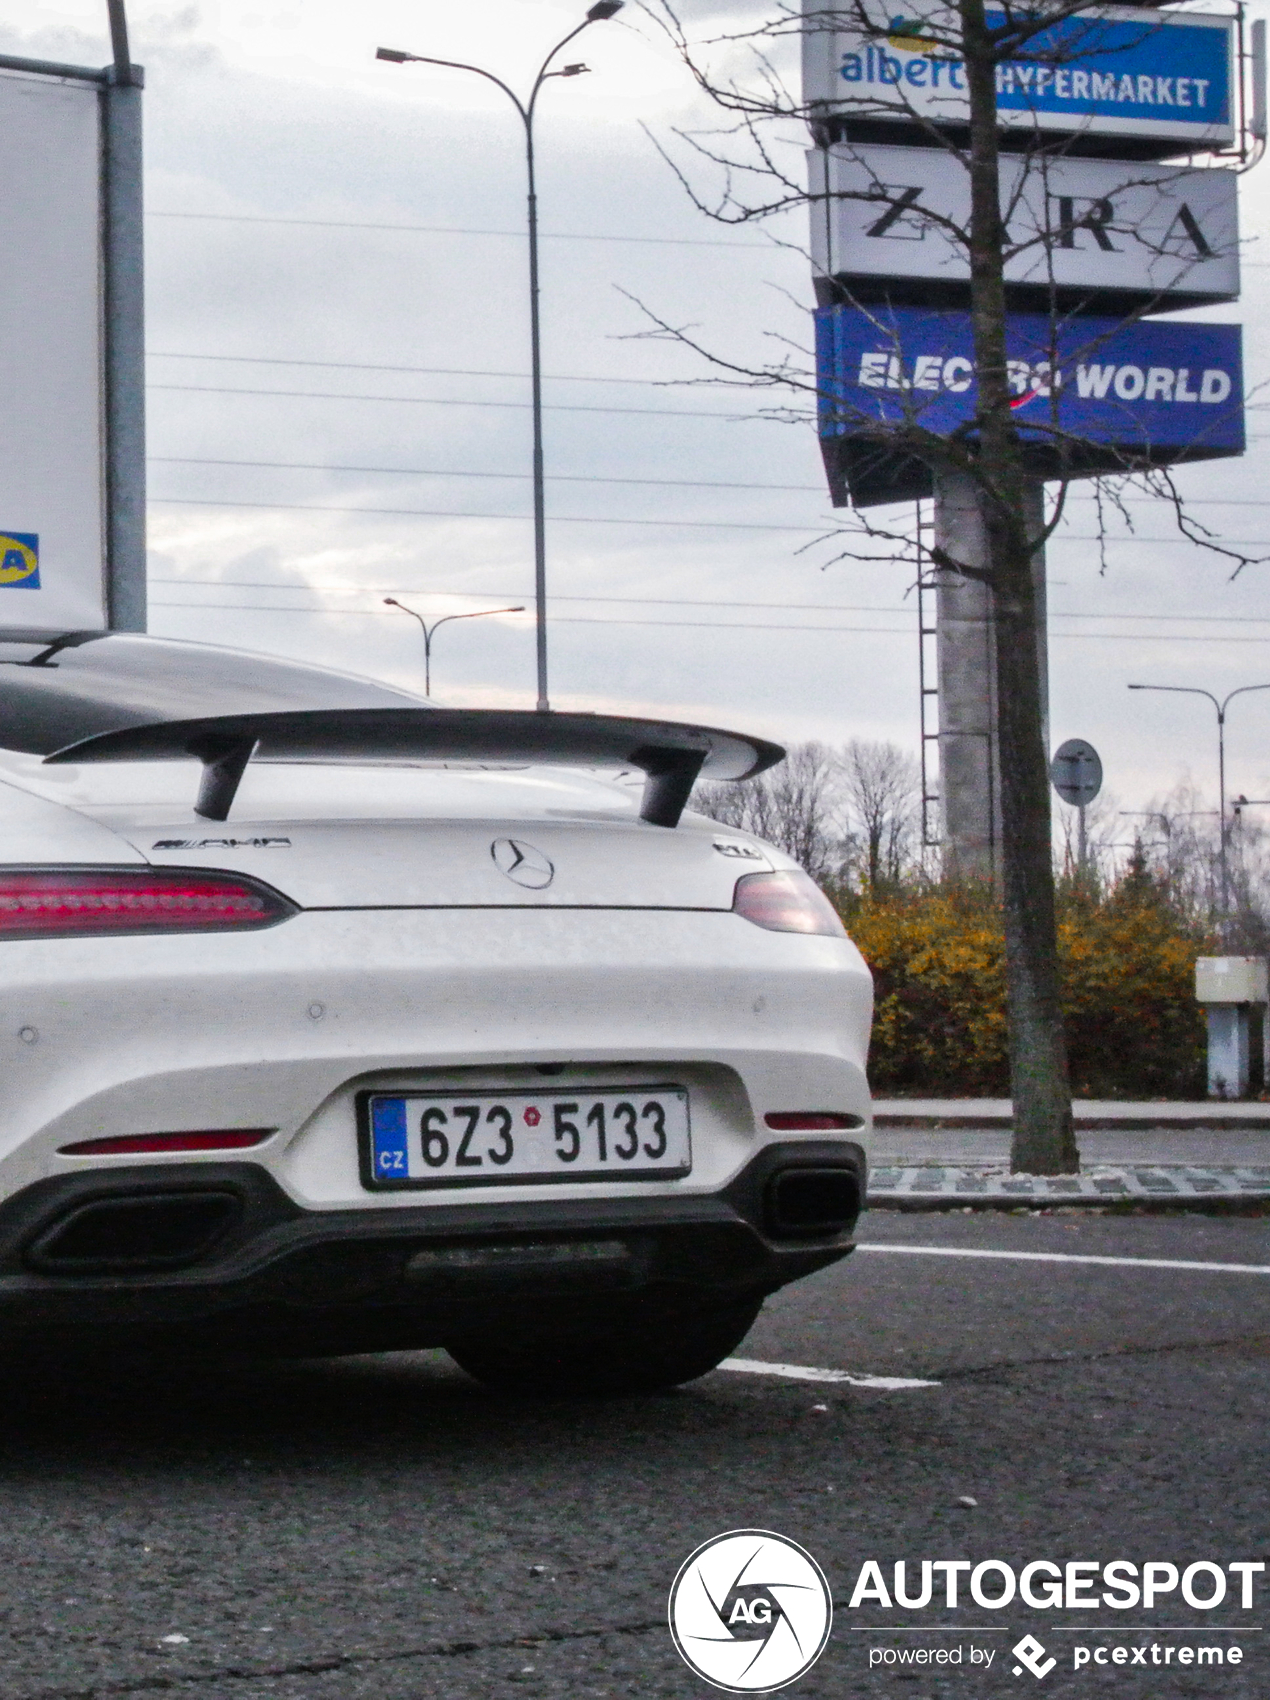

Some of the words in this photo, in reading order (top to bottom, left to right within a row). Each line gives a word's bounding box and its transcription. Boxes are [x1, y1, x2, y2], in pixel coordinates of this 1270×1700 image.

[841, 47, 965, 92] albert
[995, 63, 1210, 109] HYPERMARKET
[866, 183, 1223, 259] ZRA
[858, 352, 1061, 397] ELECRO
[1076, 363, 1231, 404] WORLD
[420, 1105, 515, 1168] 6Z3
[552, 1100, 668, 1164] 5133
[379, 1151, 404, 1169] CZ
